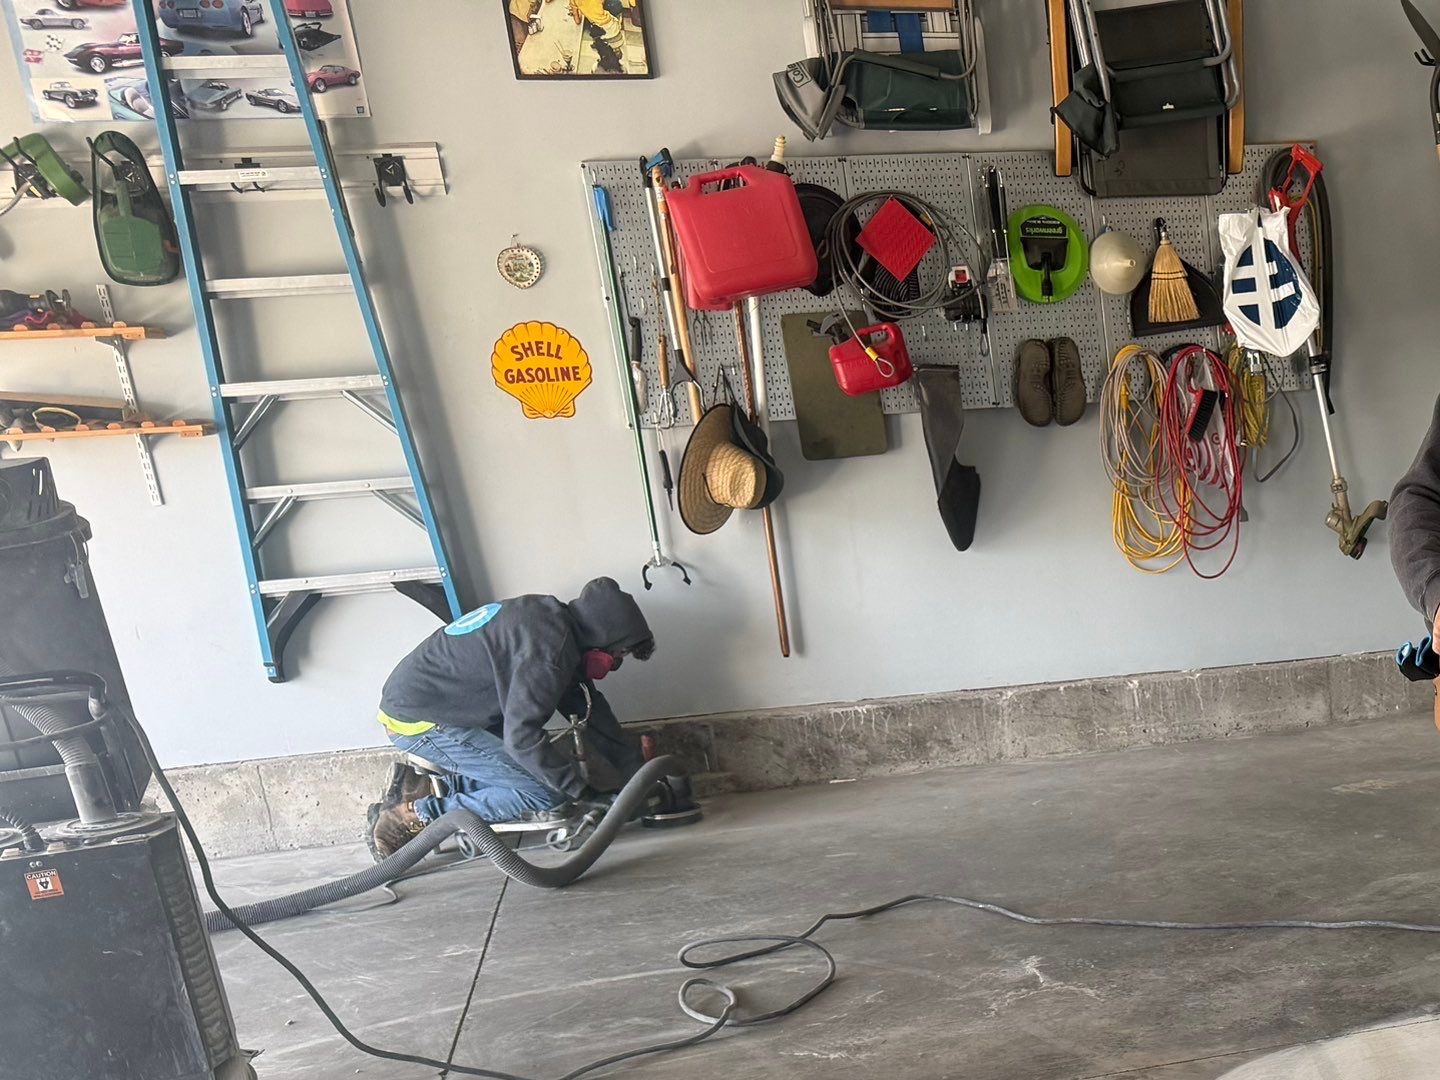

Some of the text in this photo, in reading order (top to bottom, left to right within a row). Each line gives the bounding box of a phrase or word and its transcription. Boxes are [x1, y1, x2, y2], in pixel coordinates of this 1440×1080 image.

[510, 340, 563, 362] SHELL
[504, 366, 582, 384] GASOLINE
[26, 870, 57, 880] CAUTION
